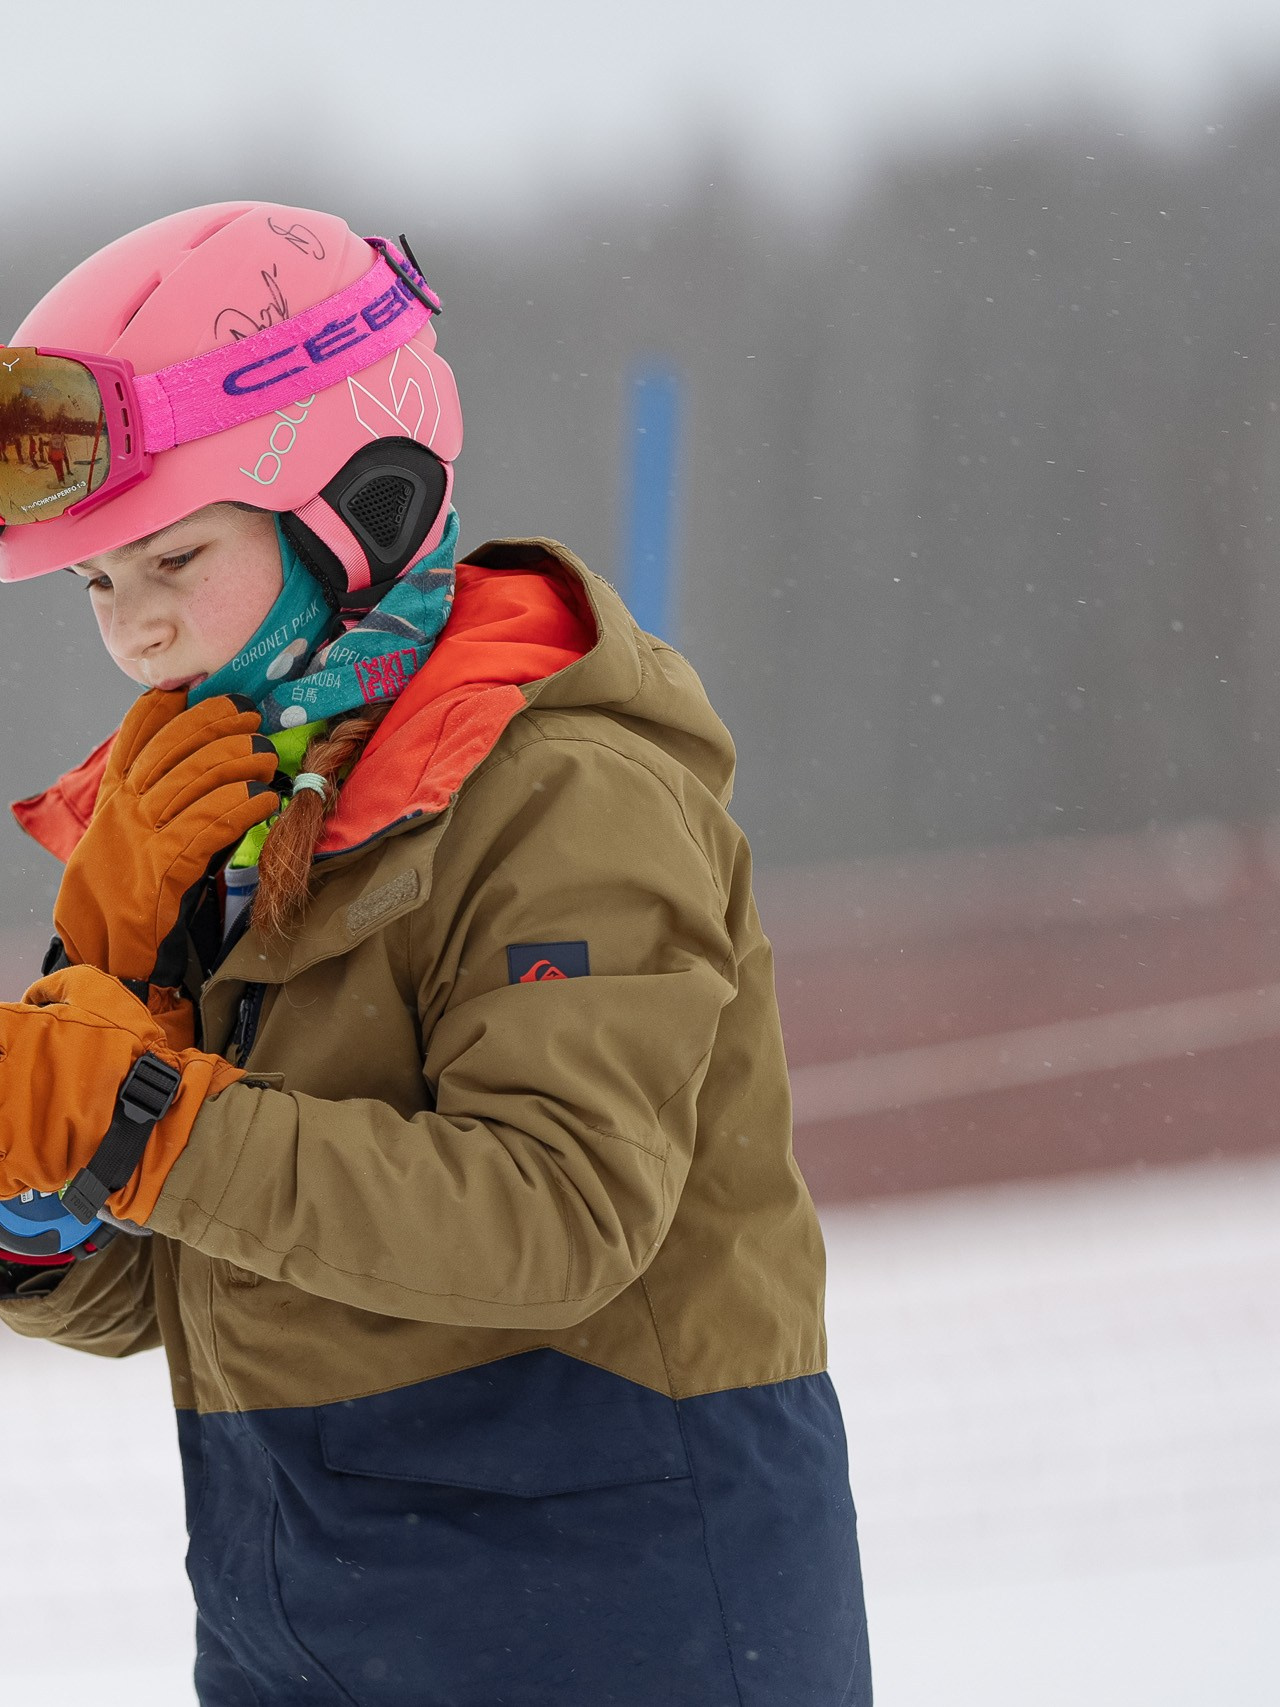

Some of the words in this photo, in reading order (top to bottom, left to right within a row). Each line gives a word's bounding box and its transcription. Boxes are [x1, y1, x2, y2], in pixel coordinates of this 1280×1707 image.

[222, 277, 417, 396] CÉB
[239, 393, 316, 485] bol
[56, 485, 77, 499] PERFO
[232, 624, 289, 672] CORONET
[291, 599, 321, 634] PEAK
[292, 686, 319, 703] 白馬
[367, 673, 417, 698] FRE
